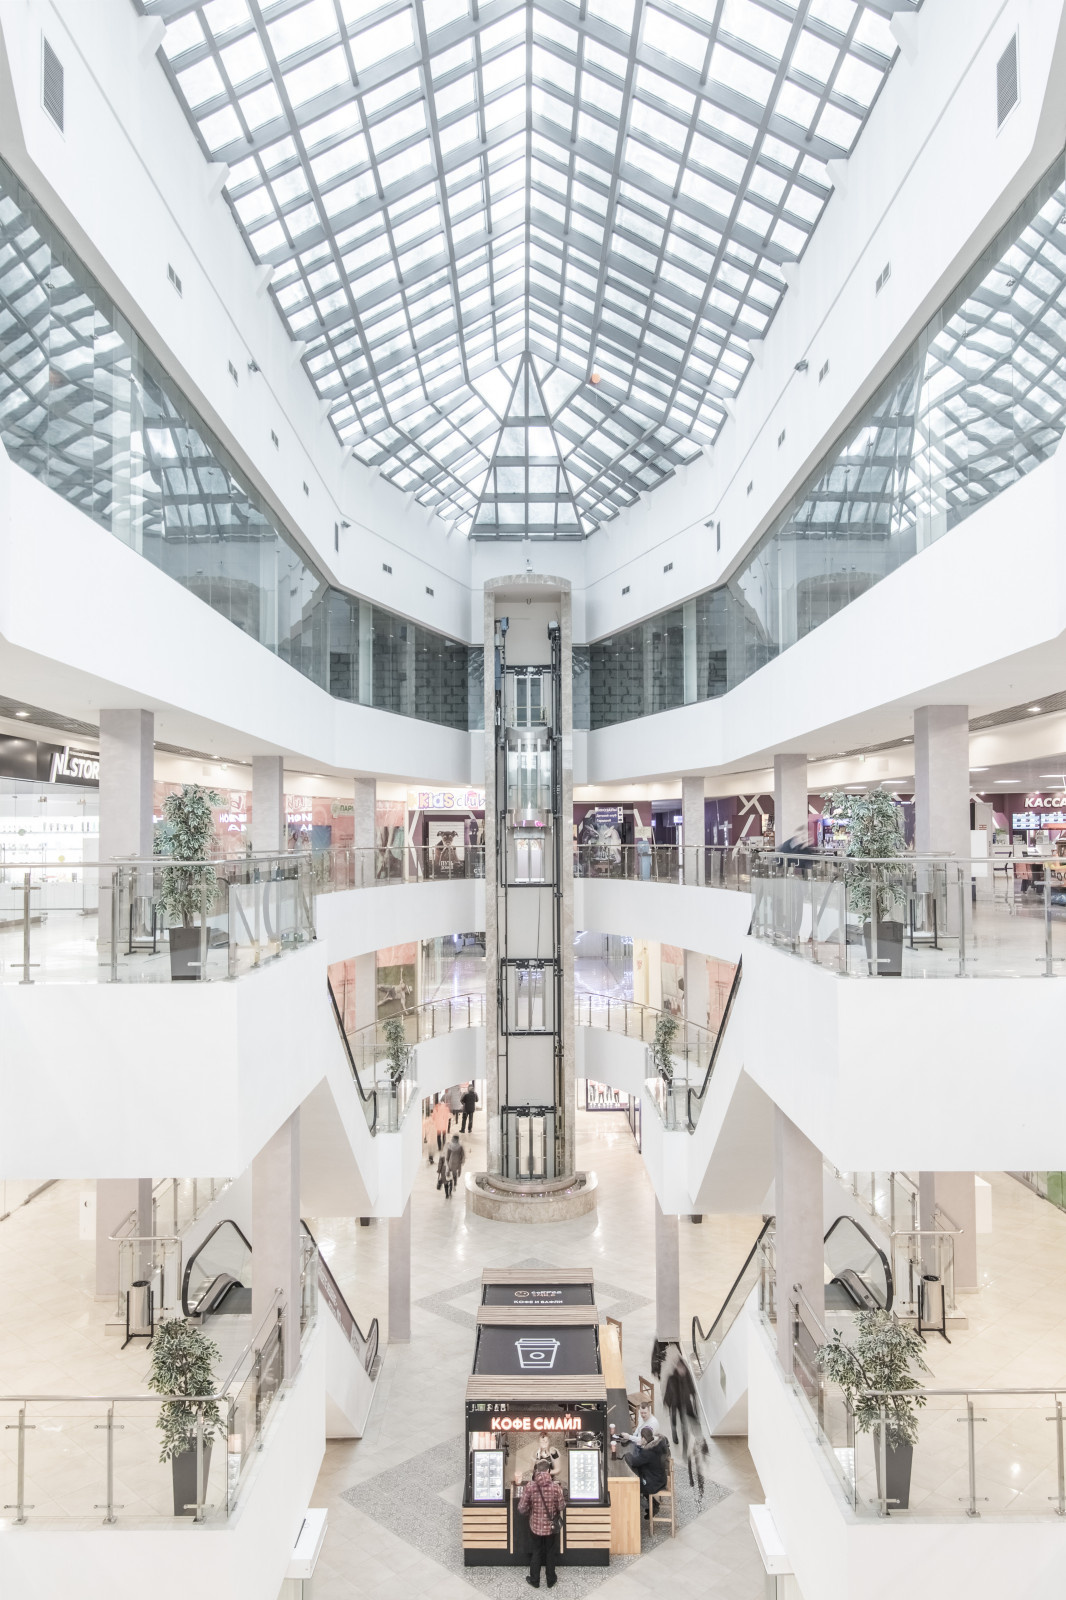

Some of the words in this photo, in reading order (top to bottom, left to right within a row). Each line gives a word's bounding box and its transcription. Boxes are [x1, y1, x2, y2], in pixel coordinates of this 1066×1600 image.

[418, 792, 454, 809] Kids
[1025, 797, 1066, 808] КАССА
[491, 1416, 531, 1430] КОФЕ
[533, 1413, 581, 1430] СМАЙЛ
